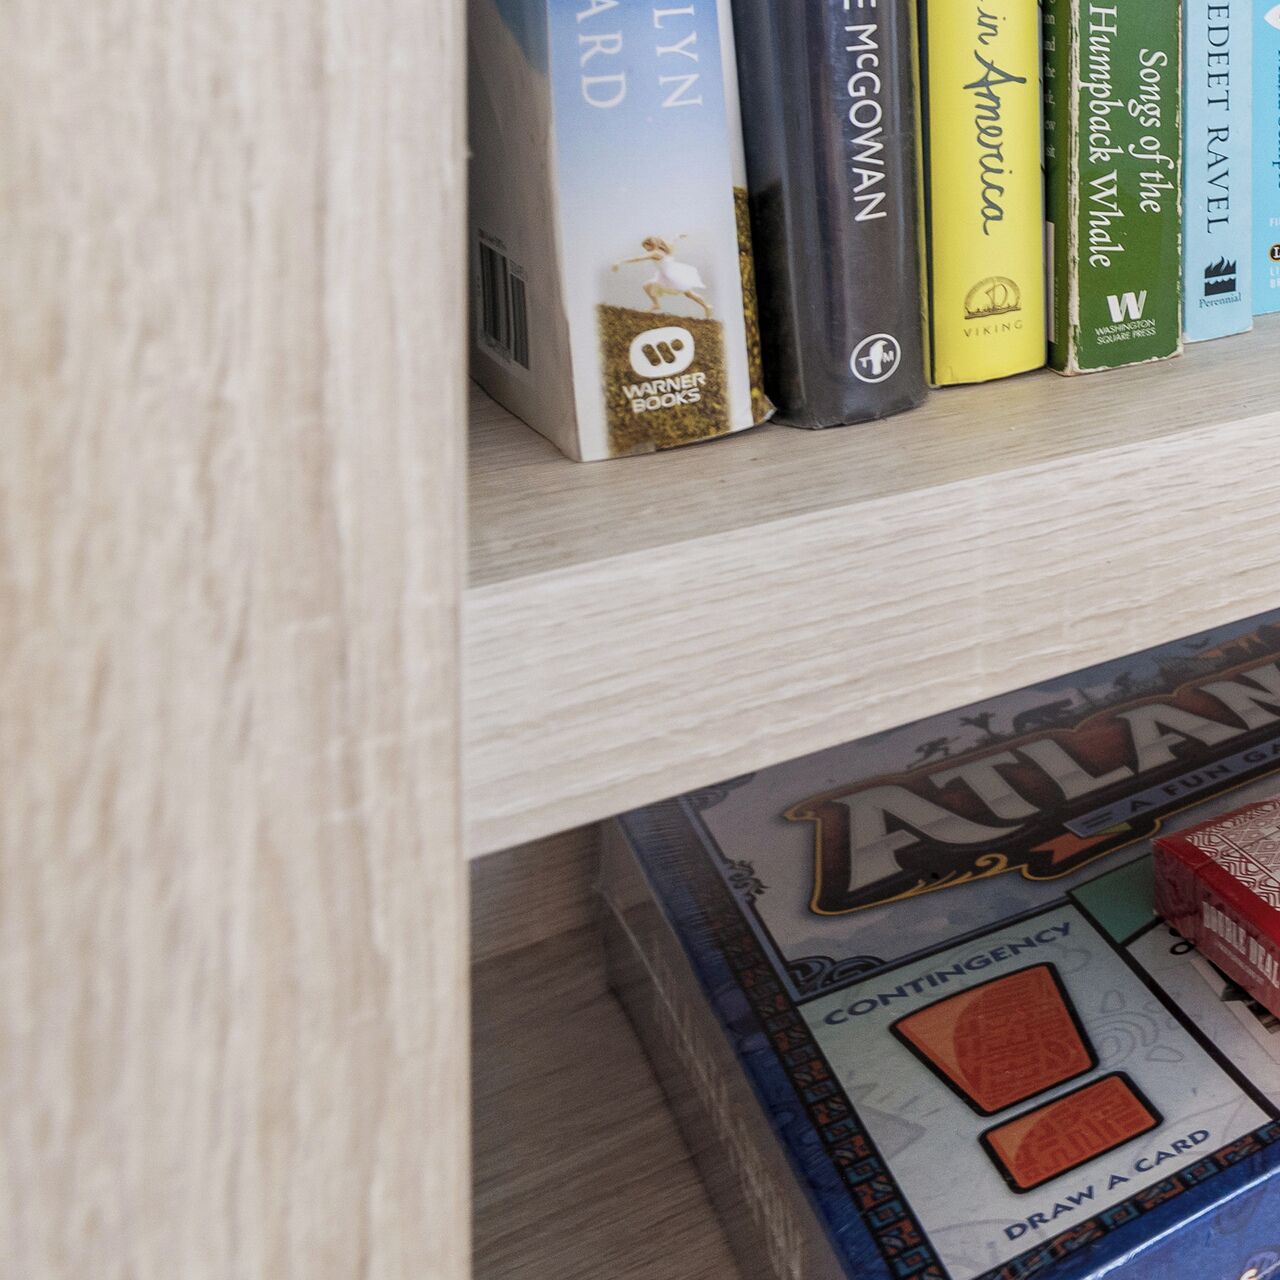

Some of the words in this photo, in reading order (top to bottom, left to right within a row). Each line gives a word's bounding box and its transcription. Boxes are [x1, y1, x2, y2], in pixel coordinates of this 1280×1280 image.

[976, 5, 1006, 46] in
[1207, 3, 1231, 111] EDEET
[1079, 2, 1125, 165] Humpback
[1127, 48, 1168, 128] Songs
[963, 48, 1027, 236] America
[1127, 135, 1175, 170] of
[1139, 170, 1175, 213] the
[1207, 125, 1231, 234] RAVEL
[1088, 169, 1126, 269] Whale
[1199, 291, 1242, 309] Perennial
[963, 319, 1023, 338] VIKING
[1095, 319, 1156, 336] WASHINGTON
[1097, 331, 1132, 345] SQUARE
[1132, 326, 1157, 339] PRESS
[621, 371, 707, 403] WARNER
[631, 387, 701, 413] BOOKS
[1161, 764, 1231, 796] FUN
[824, 921, 1073, 1026] CONTINGENCY
[1003, 1184, 1096, 1243] DRAW
[1106, 1171, 1132, 1192] A
[1132, 1128, 1211, 1174] CARD
